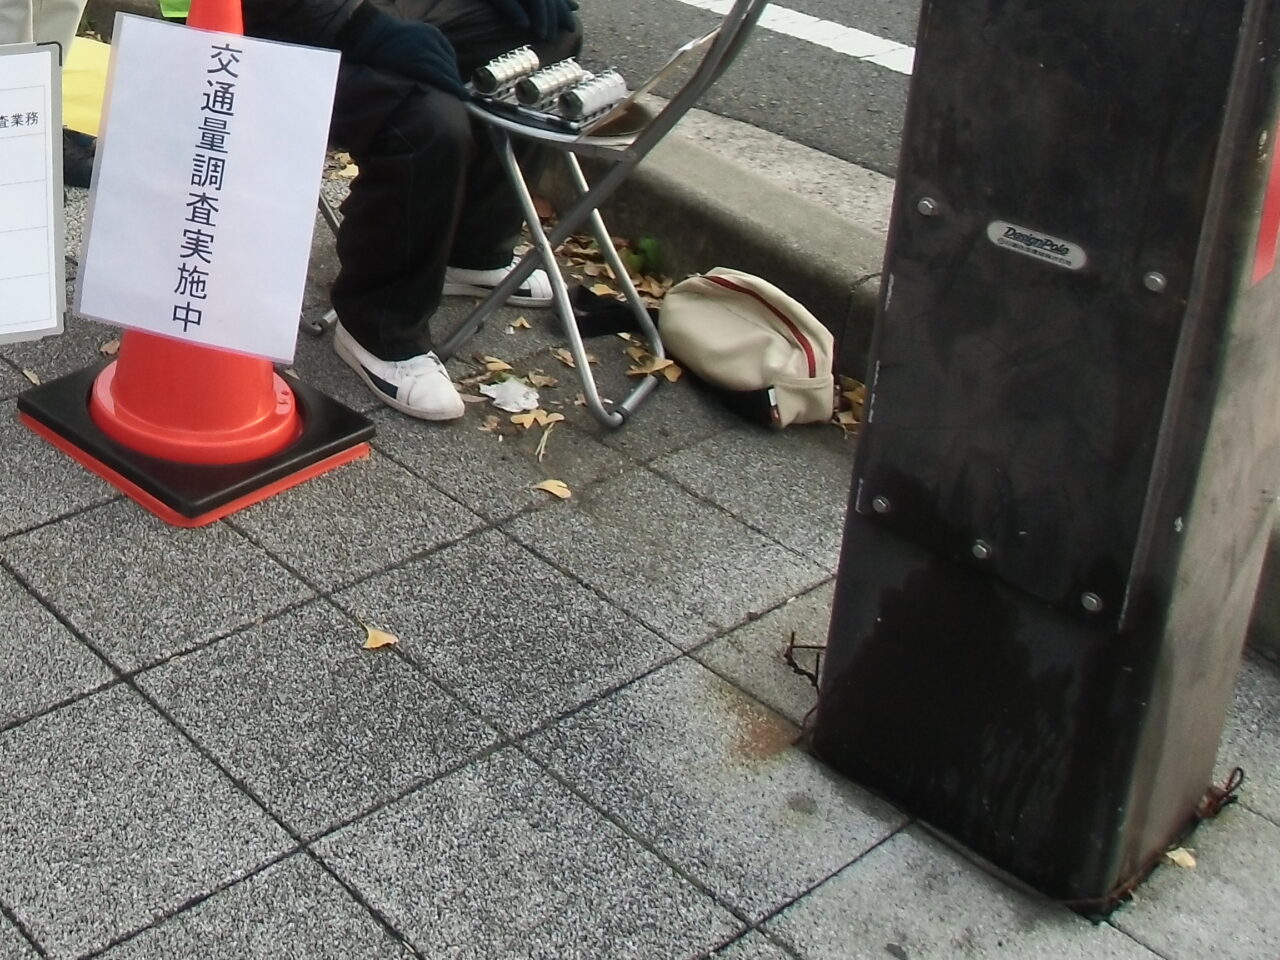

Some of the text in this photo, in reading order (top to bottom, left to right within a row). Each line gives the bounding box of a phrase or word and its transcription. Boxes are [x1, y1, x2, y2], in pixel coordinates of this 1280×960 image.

[172, 42, 244, 333] 交通量調査実施中
